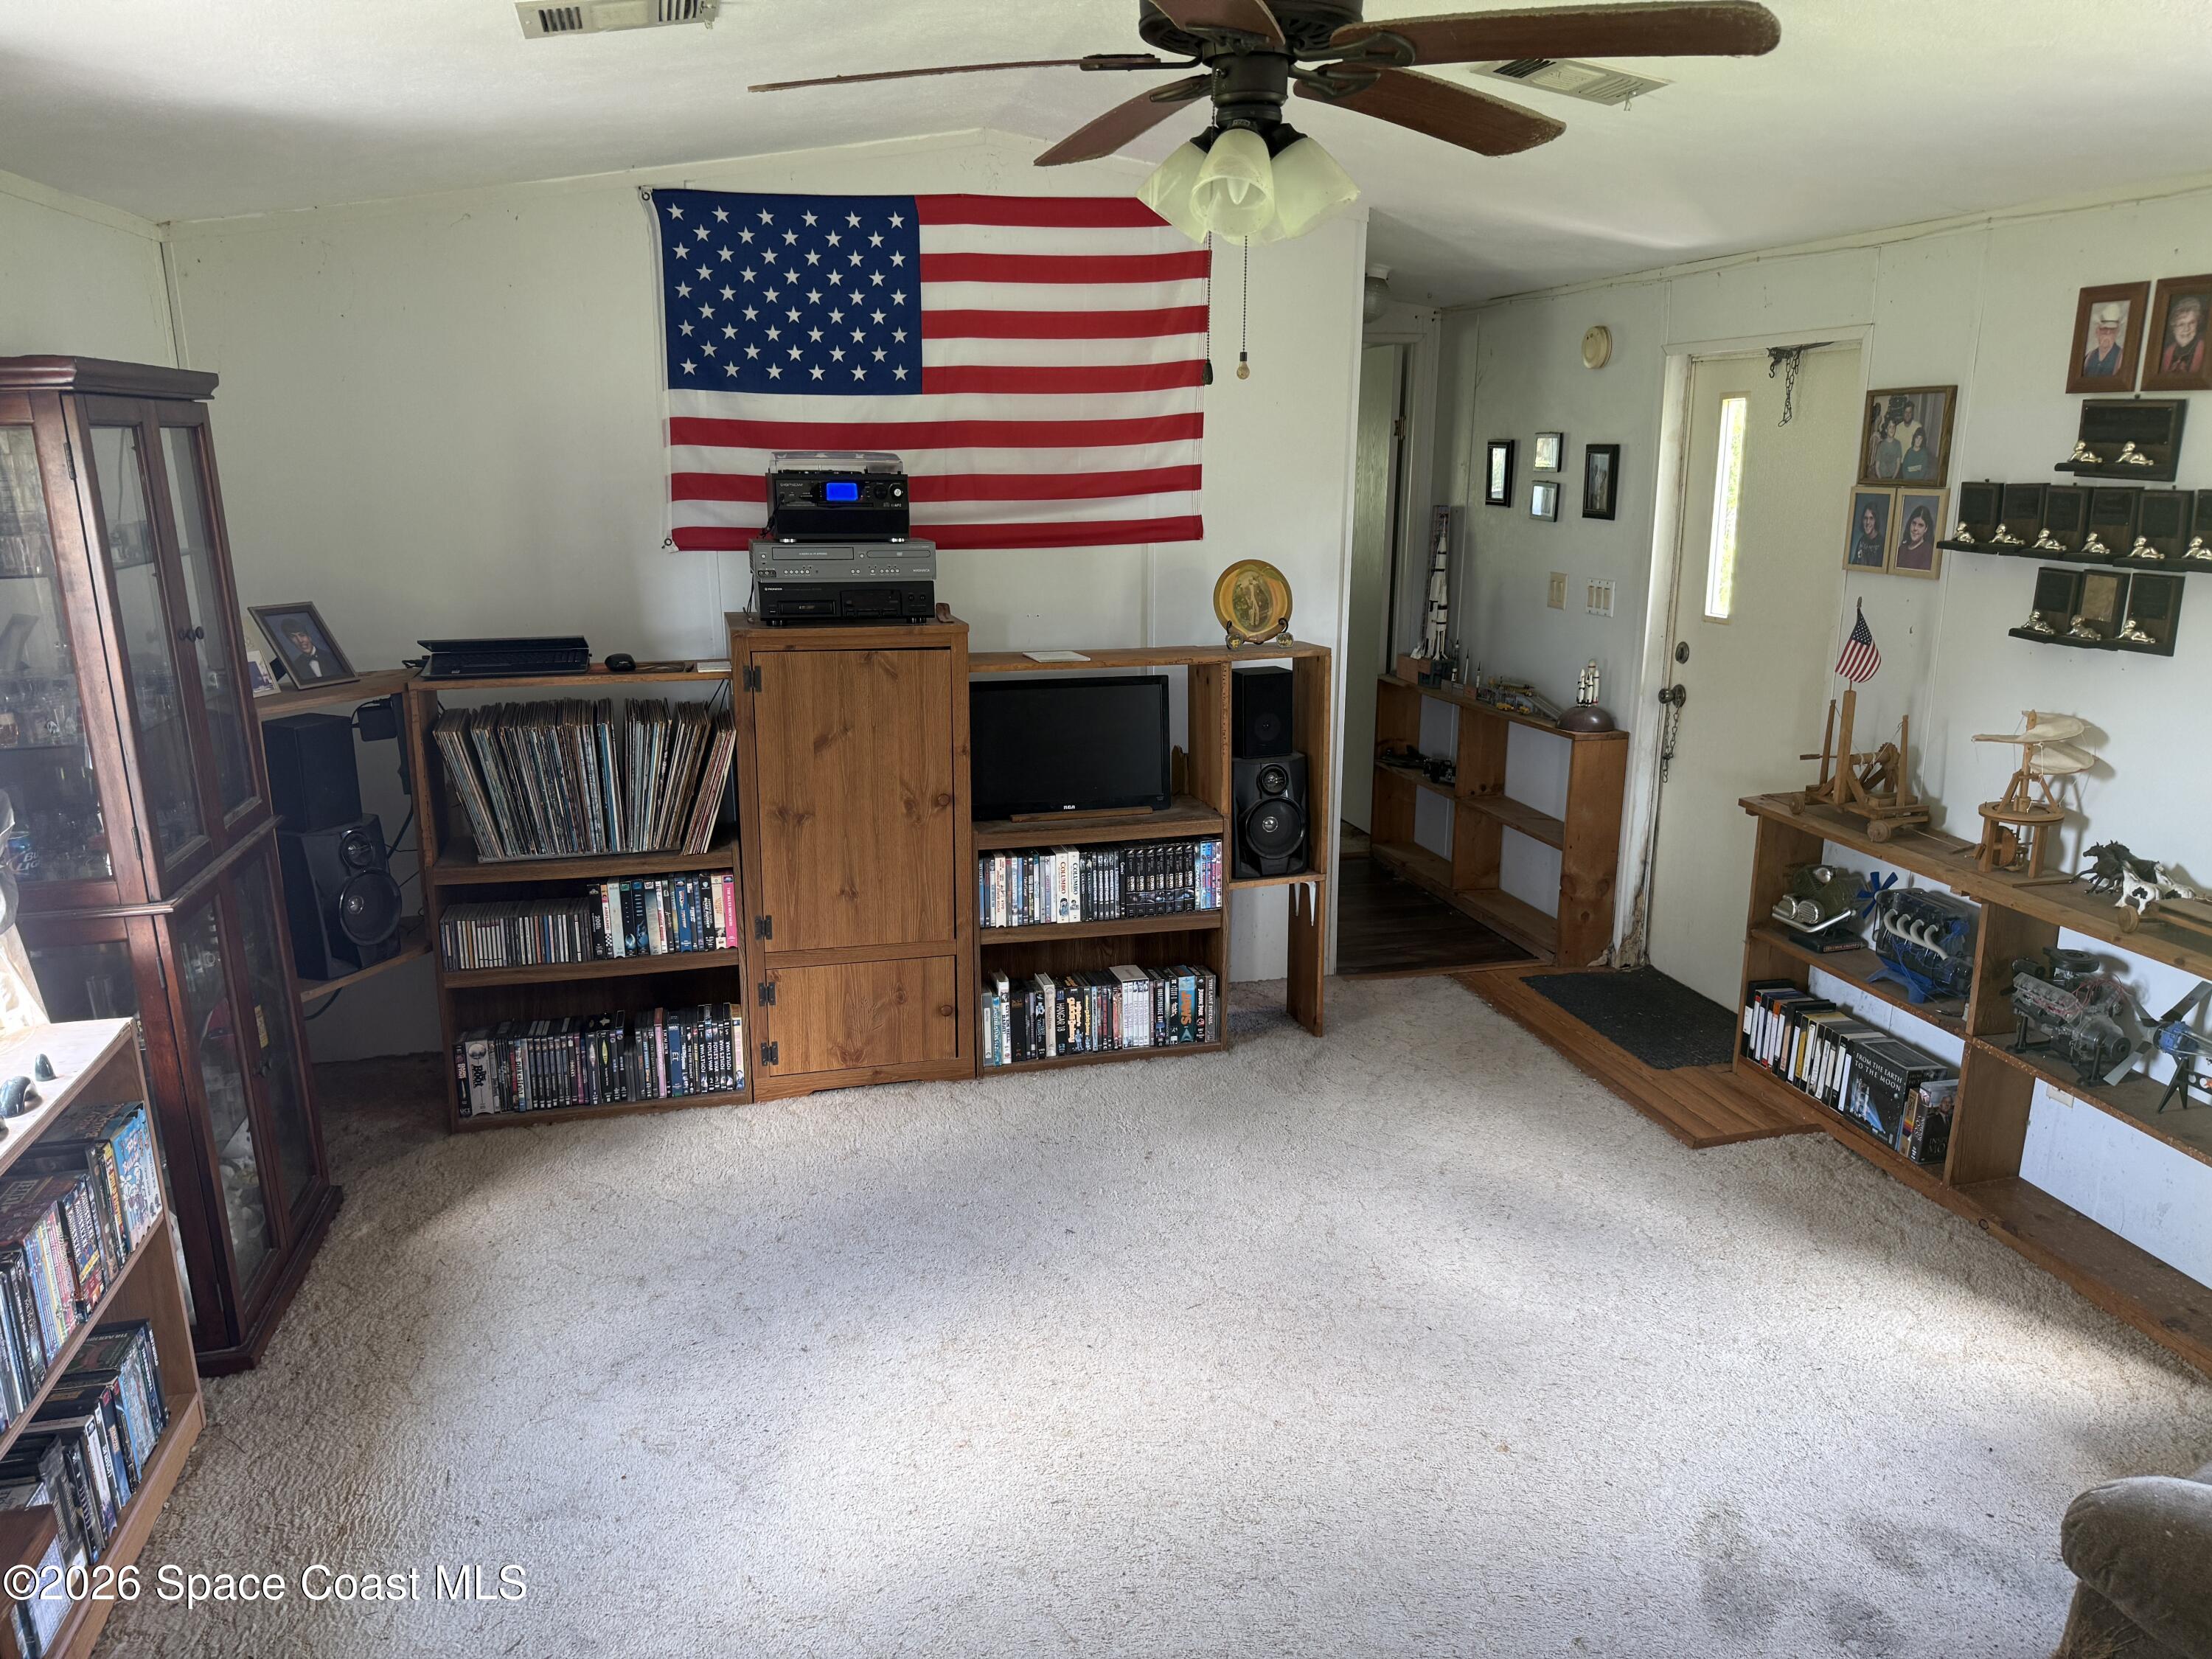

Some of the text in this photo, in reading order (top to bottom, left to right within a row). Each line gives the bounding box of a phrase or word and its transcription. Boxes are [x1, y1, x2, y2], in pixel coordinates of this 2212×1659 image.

[1057, 1003, 1065, 1026] HANGAR
[1180, 991, 1192, 1026] JAWS
[1855, 1060, 1901, 1091] TO THE MOON
[1856, 1052, 1902, 1083] FROM THE EARTH
[102, 1444, 113, 1478] snatch
